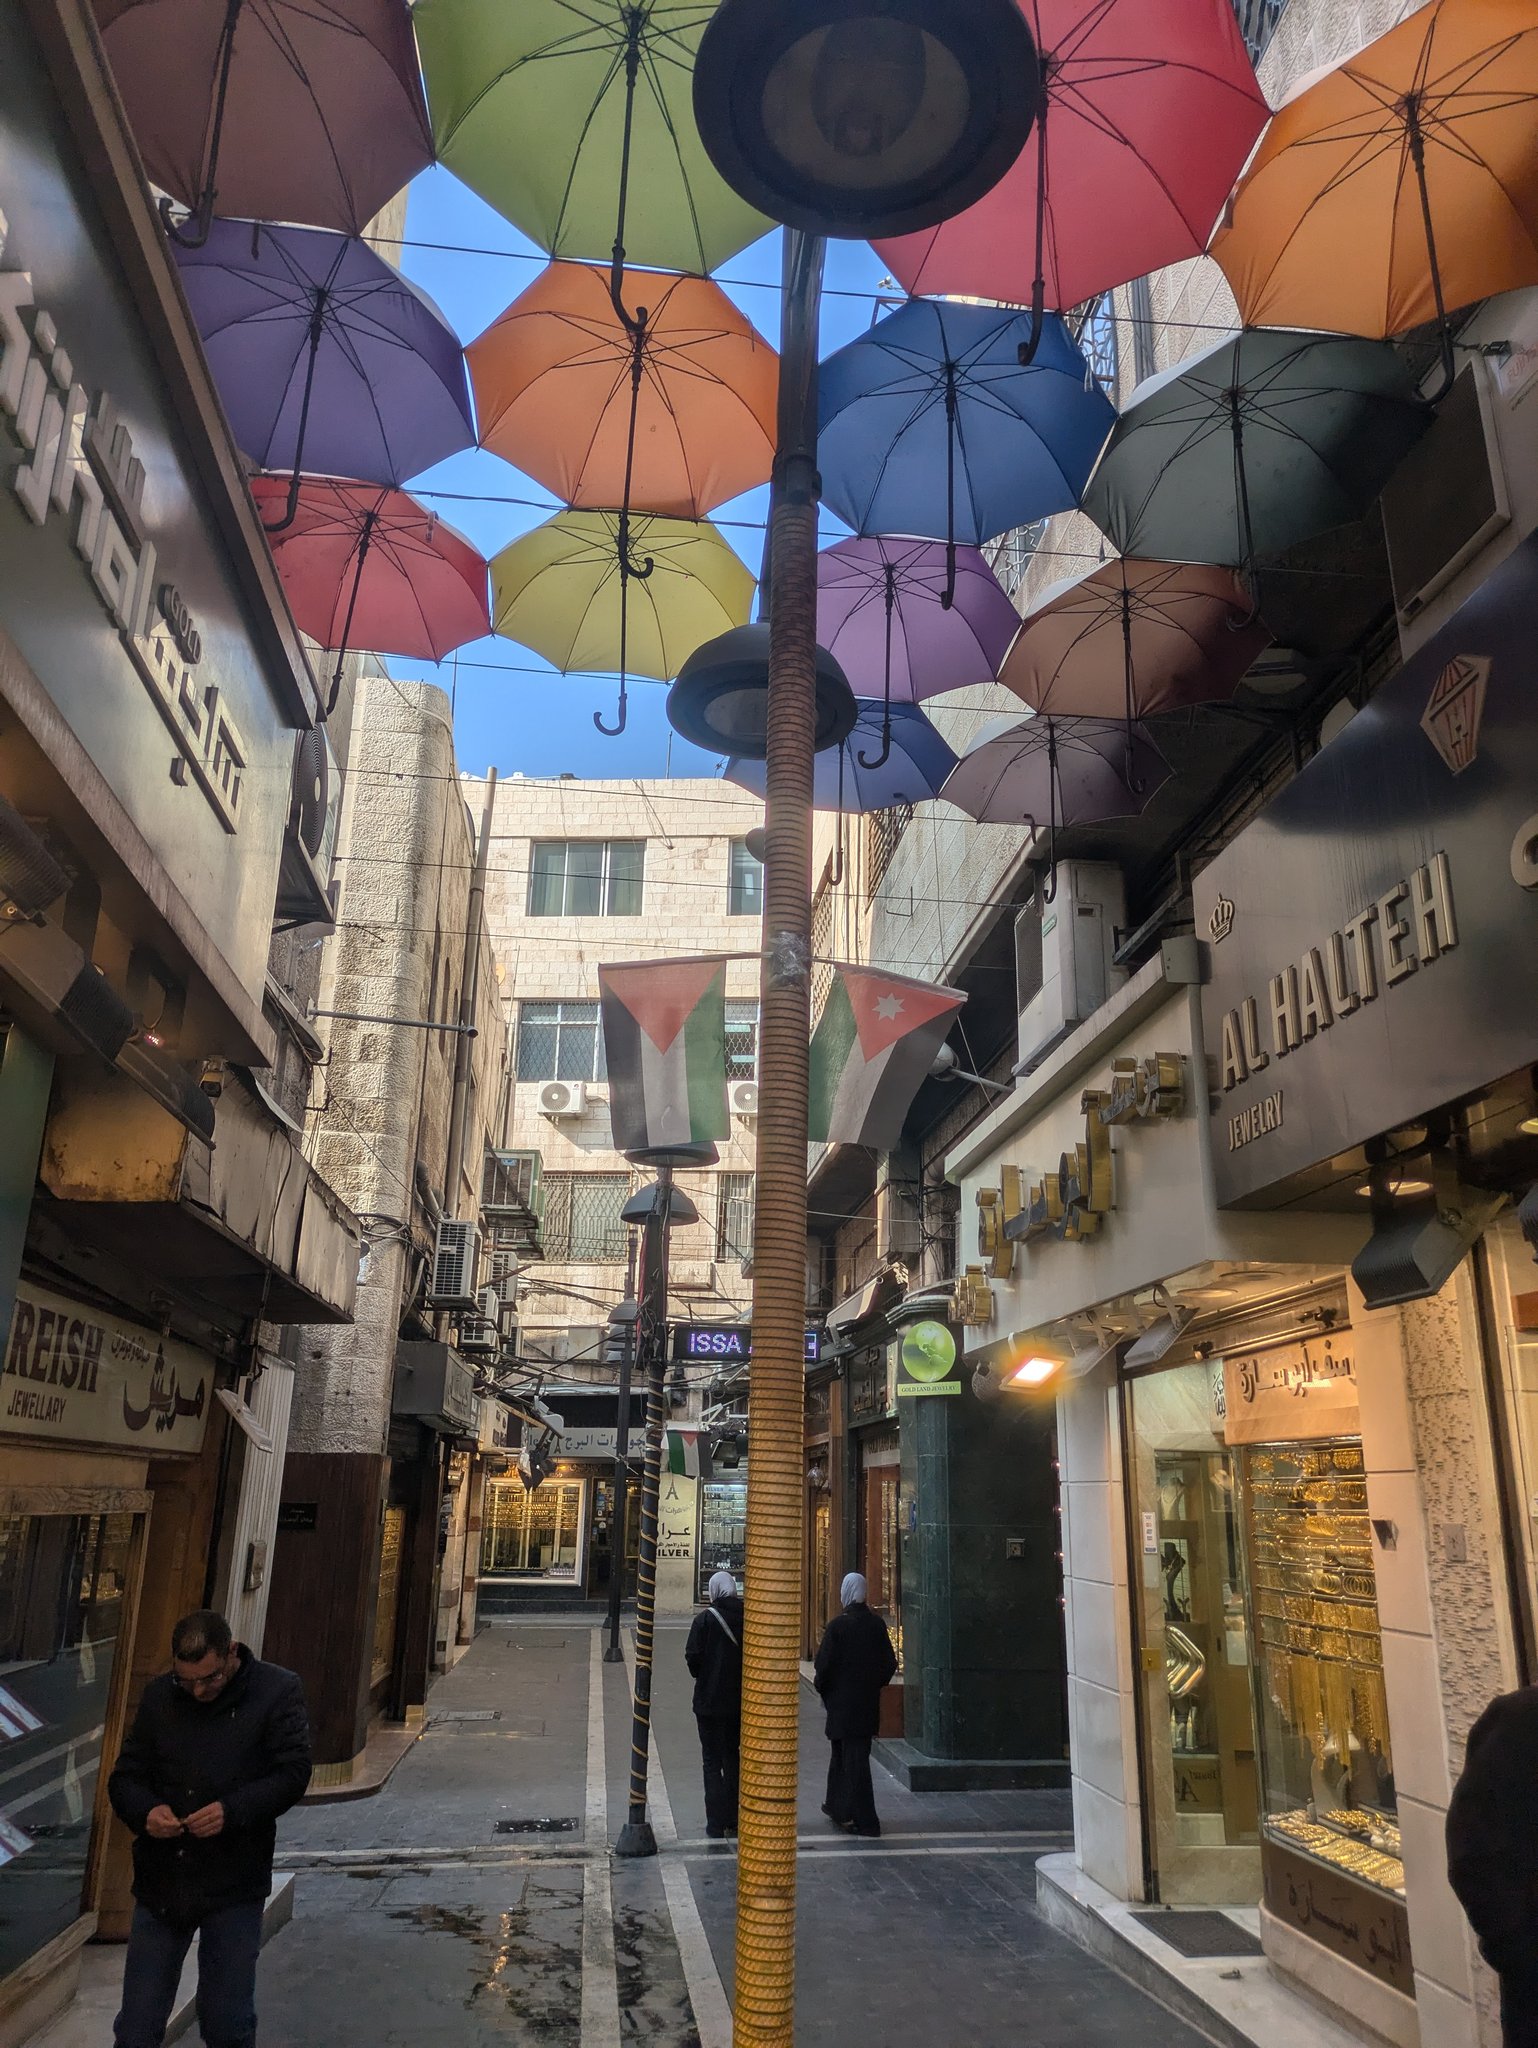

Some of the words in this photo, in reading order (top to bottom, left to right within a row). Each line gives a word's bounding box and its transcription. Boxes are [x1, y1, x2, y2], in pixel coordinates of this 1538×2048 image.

[167, 585, 202, 665] GOLD
[1222, 996, 1269, 1092] AL
[1269, 850, 1459, 1059] HALTEH
[1228, 1090, 1284, 1152] JEWELRY
[3, 1298, 106, 1393] REISH
[690, 1333, 742, 1353] ISSA
[7, 1389, 67, 1423] JEWELLARY
[565, 1434, 593, 1451] البرج
[657, 1549, 690, 1557] ILVER
